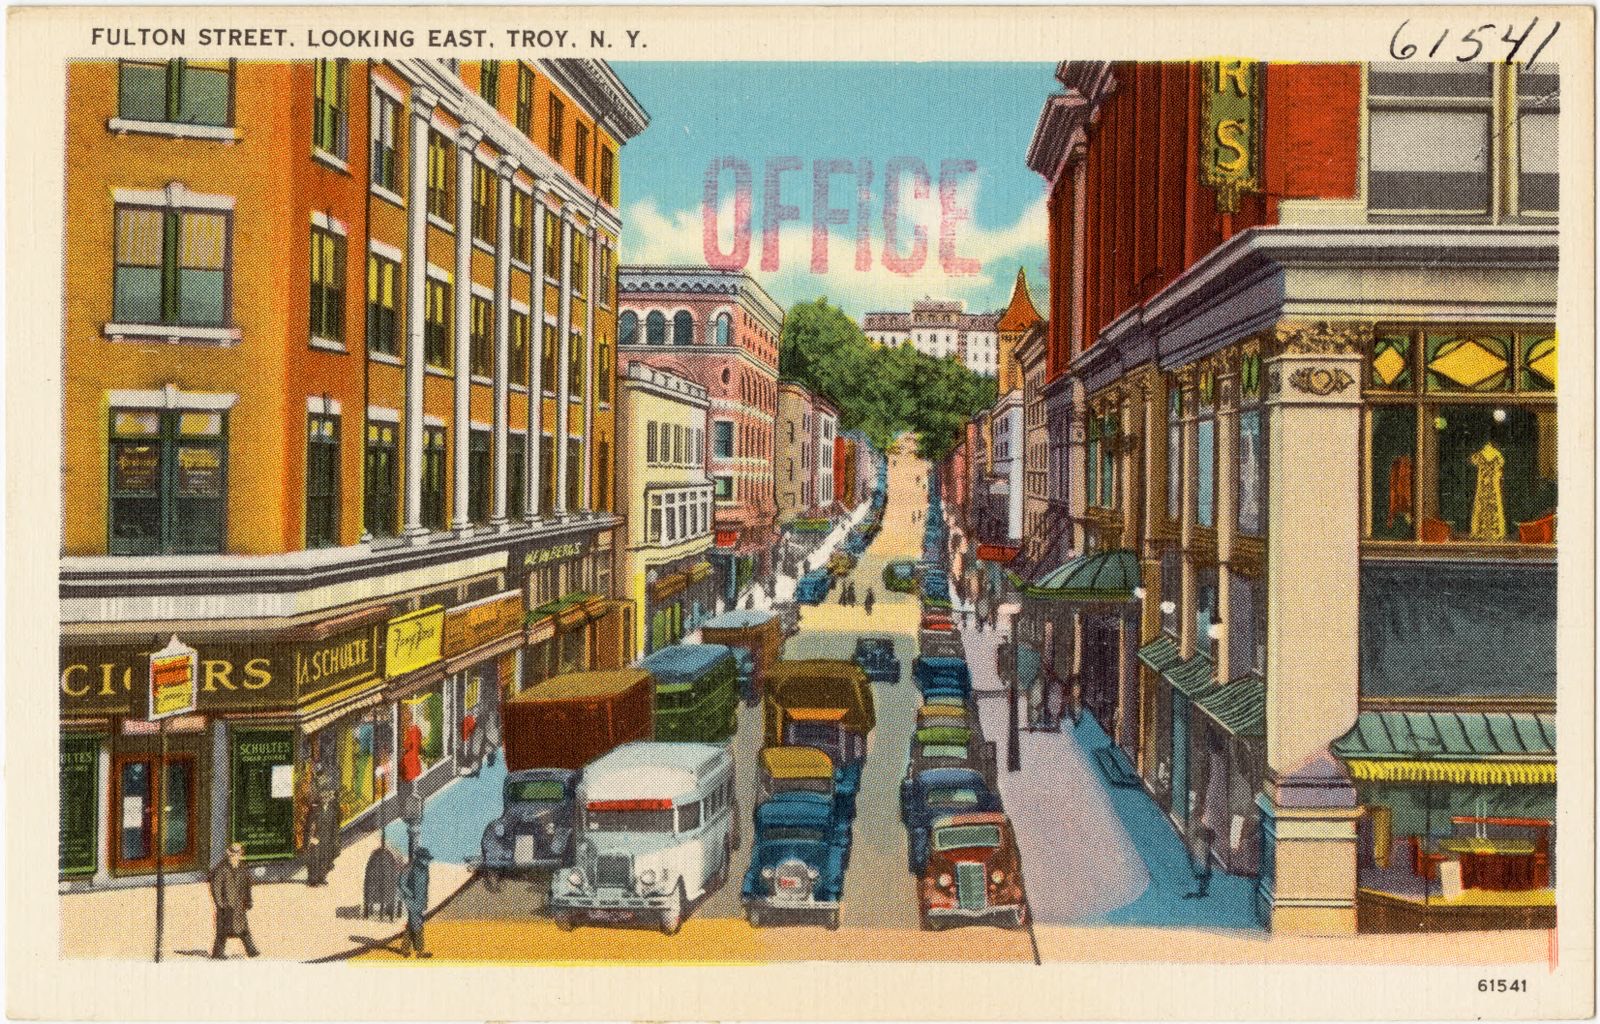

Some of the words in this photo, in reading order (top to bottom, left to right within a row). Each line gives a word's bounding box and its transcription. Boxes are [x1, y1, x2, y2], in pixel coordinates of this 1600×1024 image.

[1389, 16, 1560, 71] 61541
[61, 658, 273, 698] CIRS
[312, 639, 369, 682] SCHULTE
